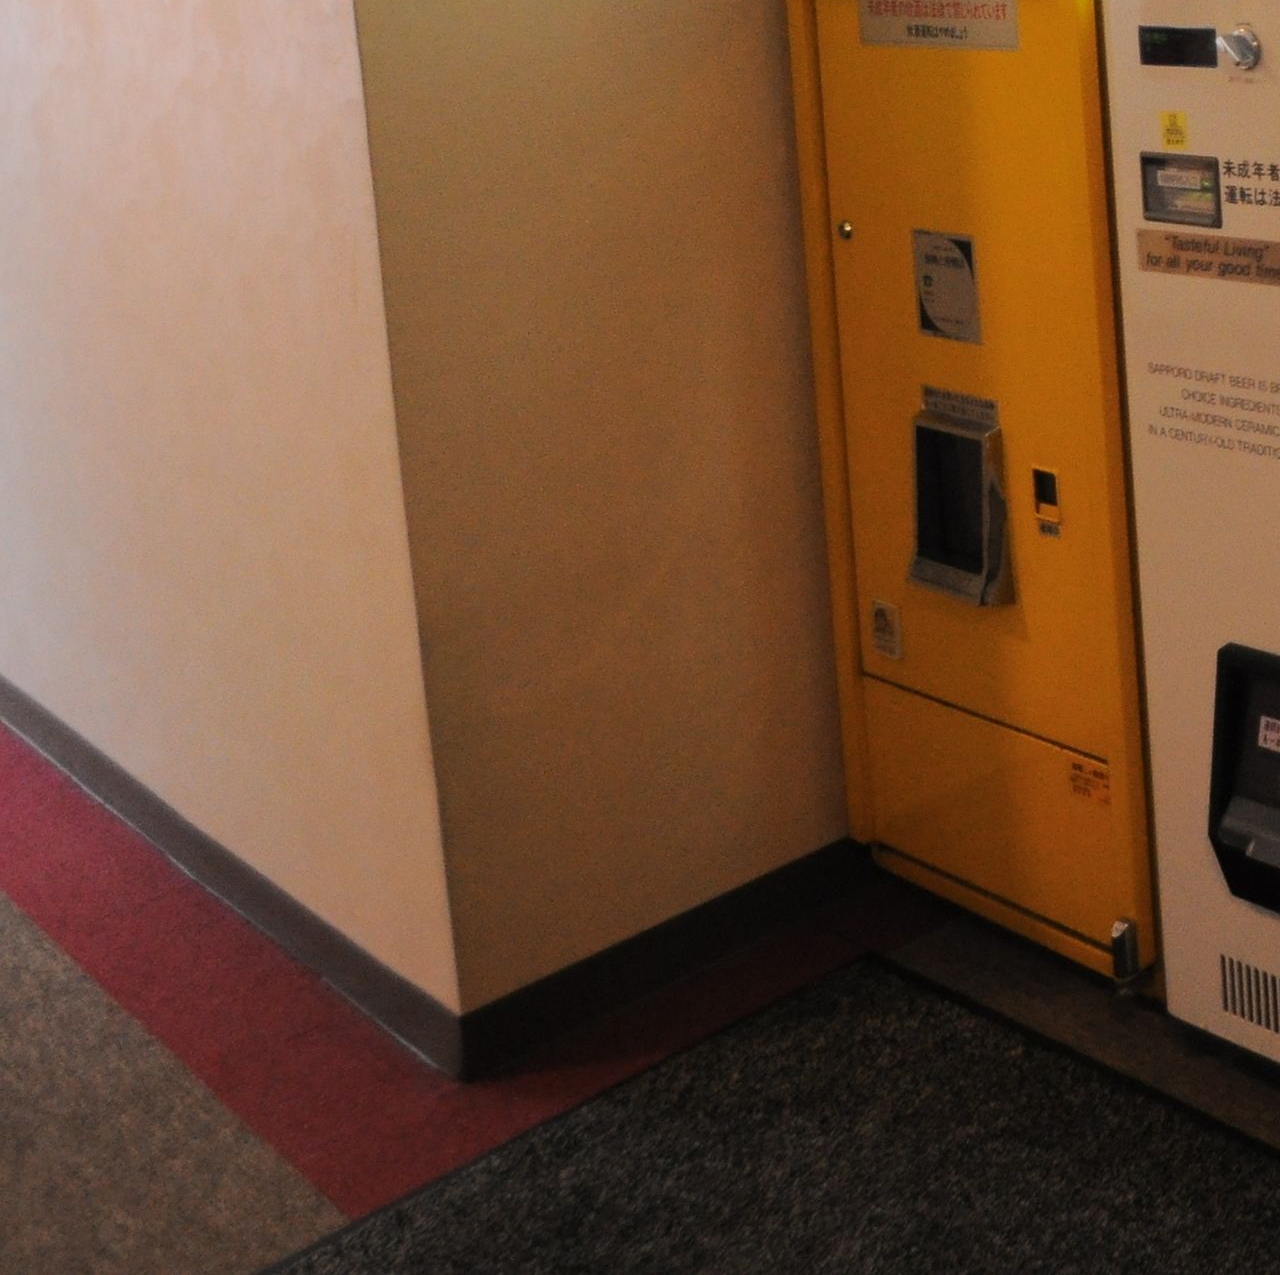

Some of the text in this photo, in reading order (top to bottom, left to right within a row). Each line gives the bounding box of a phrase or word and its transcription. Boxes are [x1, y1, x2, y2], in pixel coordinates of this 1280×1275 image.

[1146, 251, 1161, 266] for
[1166, 253, 1180, 268] all
[1186, 258, 1213, 274] your
[1148, 362, 1192, 380] SAPPORO
[1194, 370, 1226, 384] DRAFT
[1229, 375, 1255, 389] BEER
[1258, 380, 1269, 391] IS
[1181, 388, 1216, 405] CHOICE
[1160, 427, 1167, 437] A
[1235, 419, 1280, 437] CERAMIC
